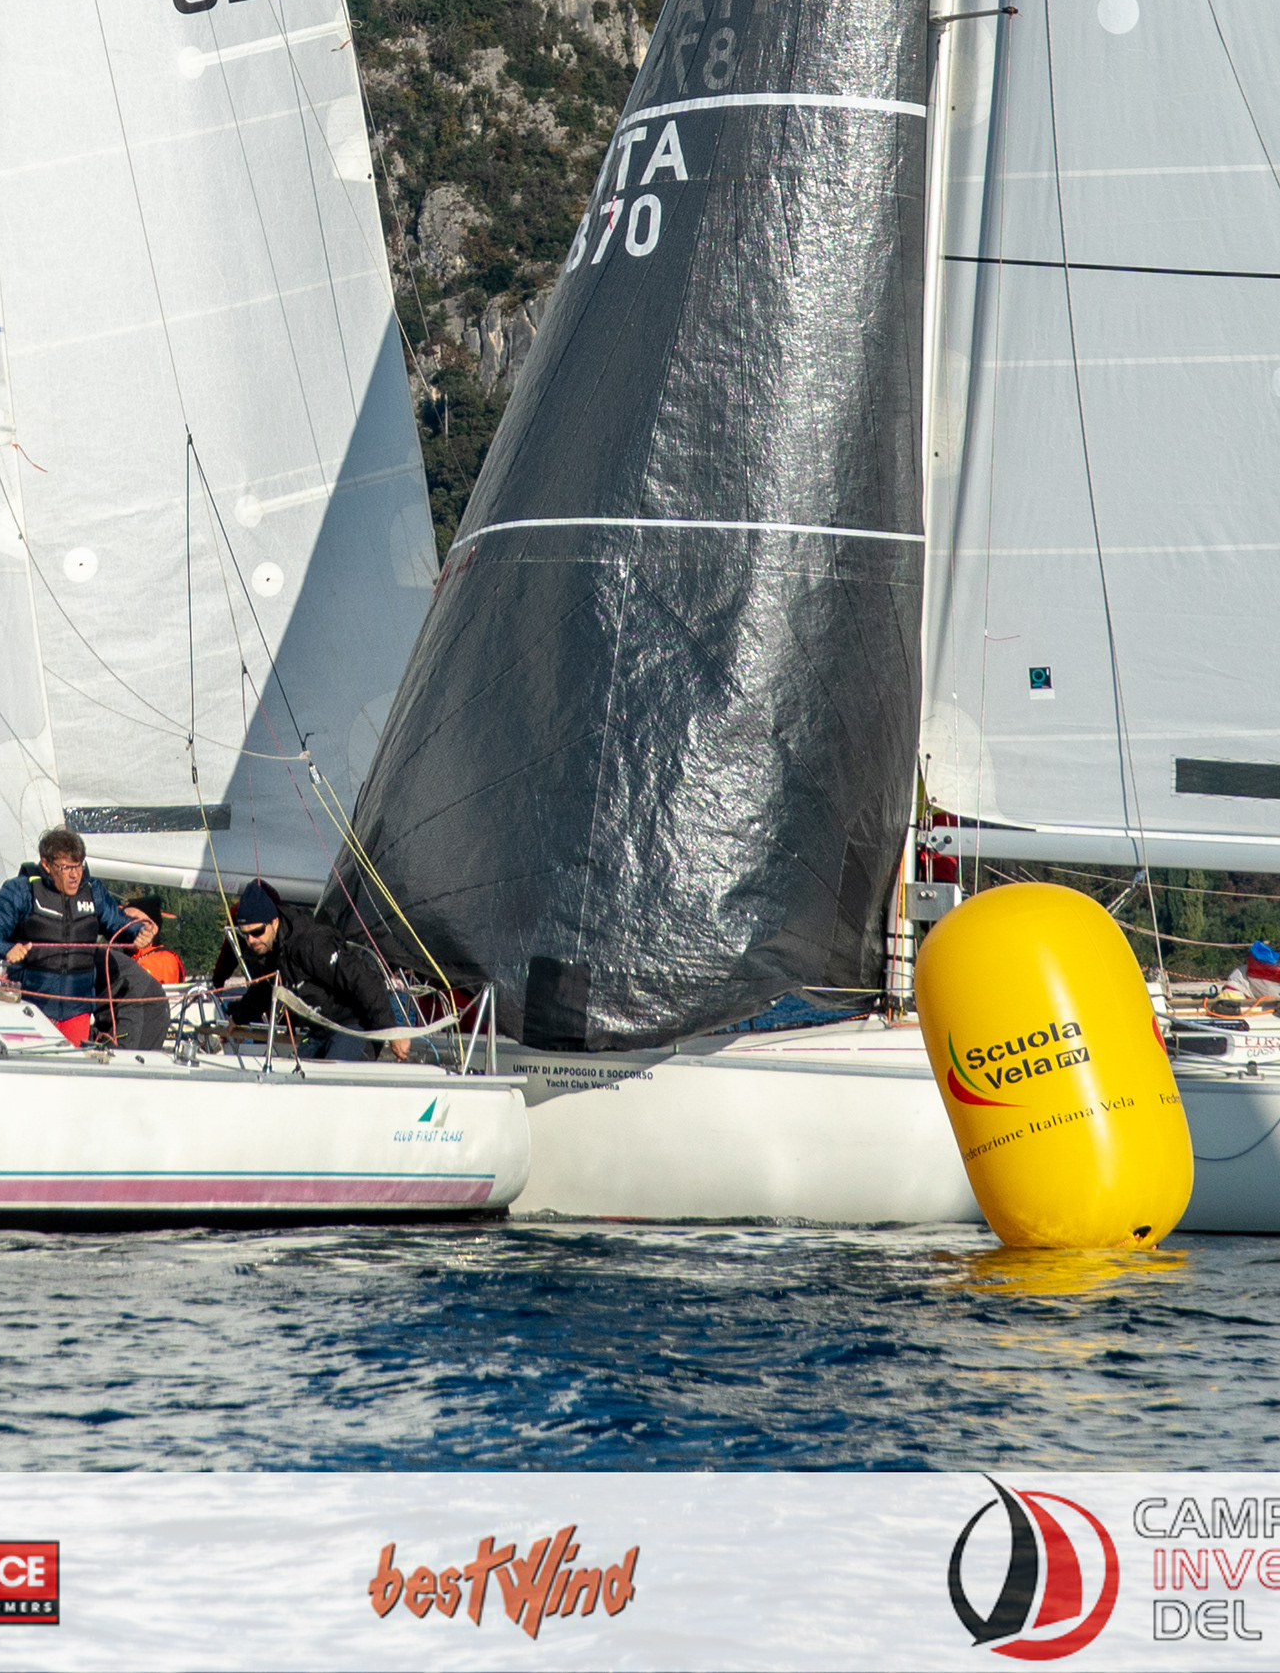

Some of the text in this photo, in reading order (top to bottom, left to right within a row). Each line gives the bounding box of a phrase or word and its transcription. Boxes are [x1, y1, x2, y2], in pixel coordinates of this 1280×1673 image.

[966, 1022, 1082, 1069] Scuola
[542, 1066, 551, 1075] DI
[553, 1067, 597, 1077] APPOGGIO
[599, 1069, 604, 1078] E
[606, 1069, 653, 1080] SOCCORSO
[984, 1048, 1088, 1089] Vela FIV
[546, 1078, 619, 1090] Yacht Club Verona
[393, 1130, 464, 1142] CLUB FIRST CLASS
[963, 1096, 1135, 1161] ederazione Italiana Vela
